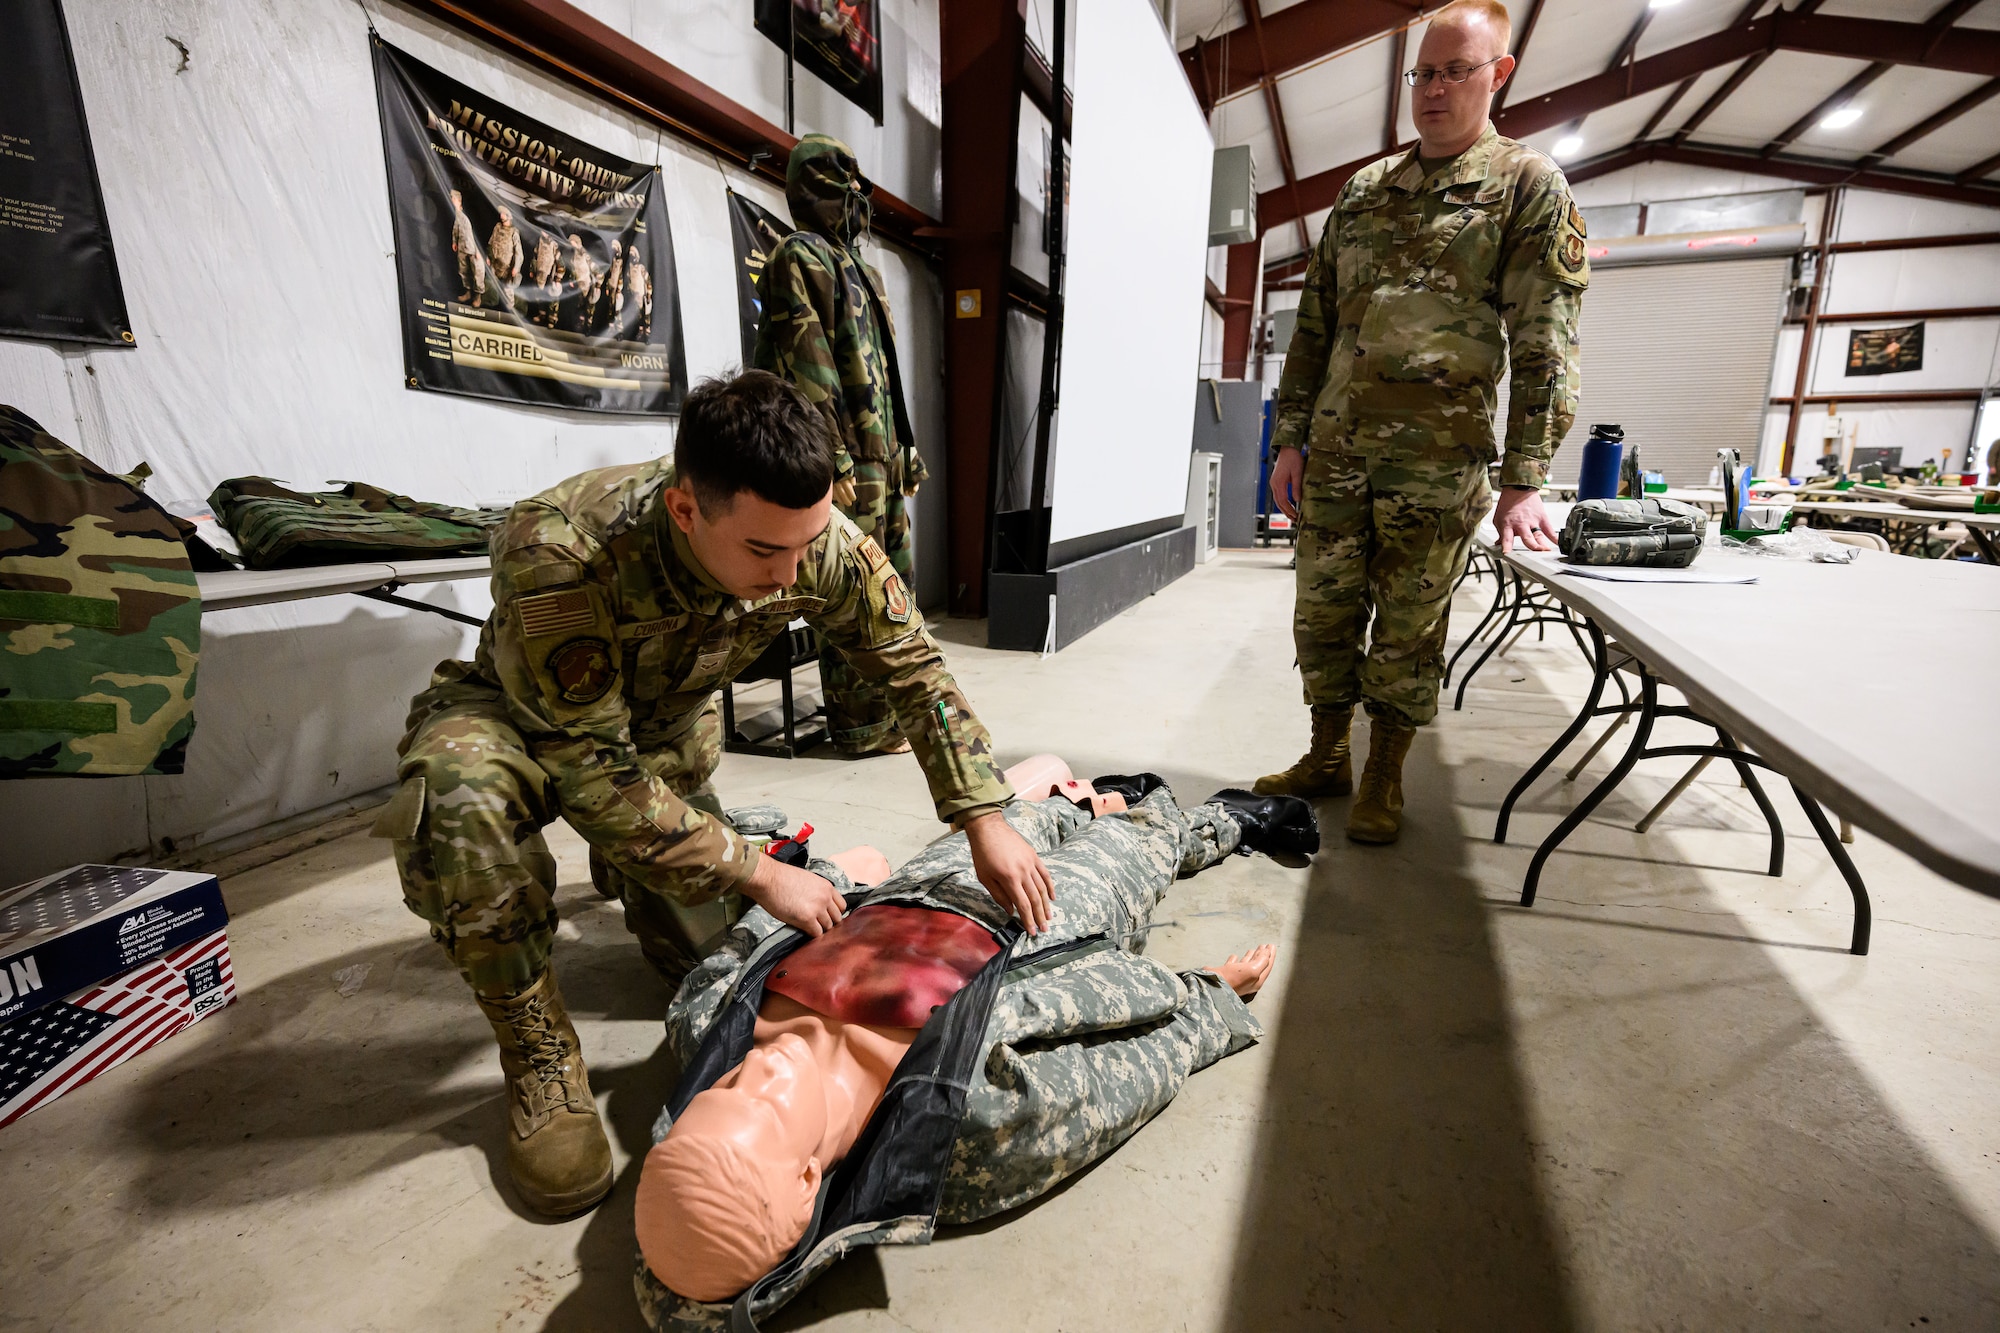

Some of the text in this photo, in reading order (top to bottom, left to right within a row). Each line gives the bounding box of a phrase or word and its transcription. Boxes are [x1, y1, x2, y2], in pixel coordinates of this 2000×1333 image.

[2, 134, 18, 142] your
[445, 98, 634, 191] MISSION-ORIENTE
[4, 197, 19, 205] your
[21, 200, 56, 212] protective
[5, 206, 28, 215] proper
[29, 209, 47, 218] wear
[11, 220, 23, 228] the
[48, 219, 63, 228] The
[458, 333, 543, 362] CARRIED
[620, 353, 664, 370] WORN
[769, 601, 786, 612] AIR
[788, 597, 822, 611] FORCE
[633, 618, 679, 637] CORONA
[120, 906, 203, 944] Every purchase supports the
[122, 911, 205, 950] Blinded Veterans Association
[123, 935, 166, 957] 30% Recycled
[125, 944, 163, 965] SFI Certified
[190, 959, 215, 975] Proudly
[194, 968, 213, 980] Made
[203, 974, 214, 984] the
[195, 981, 216, 995] U.S.A.
[0, 1001, 24, 1017] aper
[194, 991, 223, 1013] BSC
